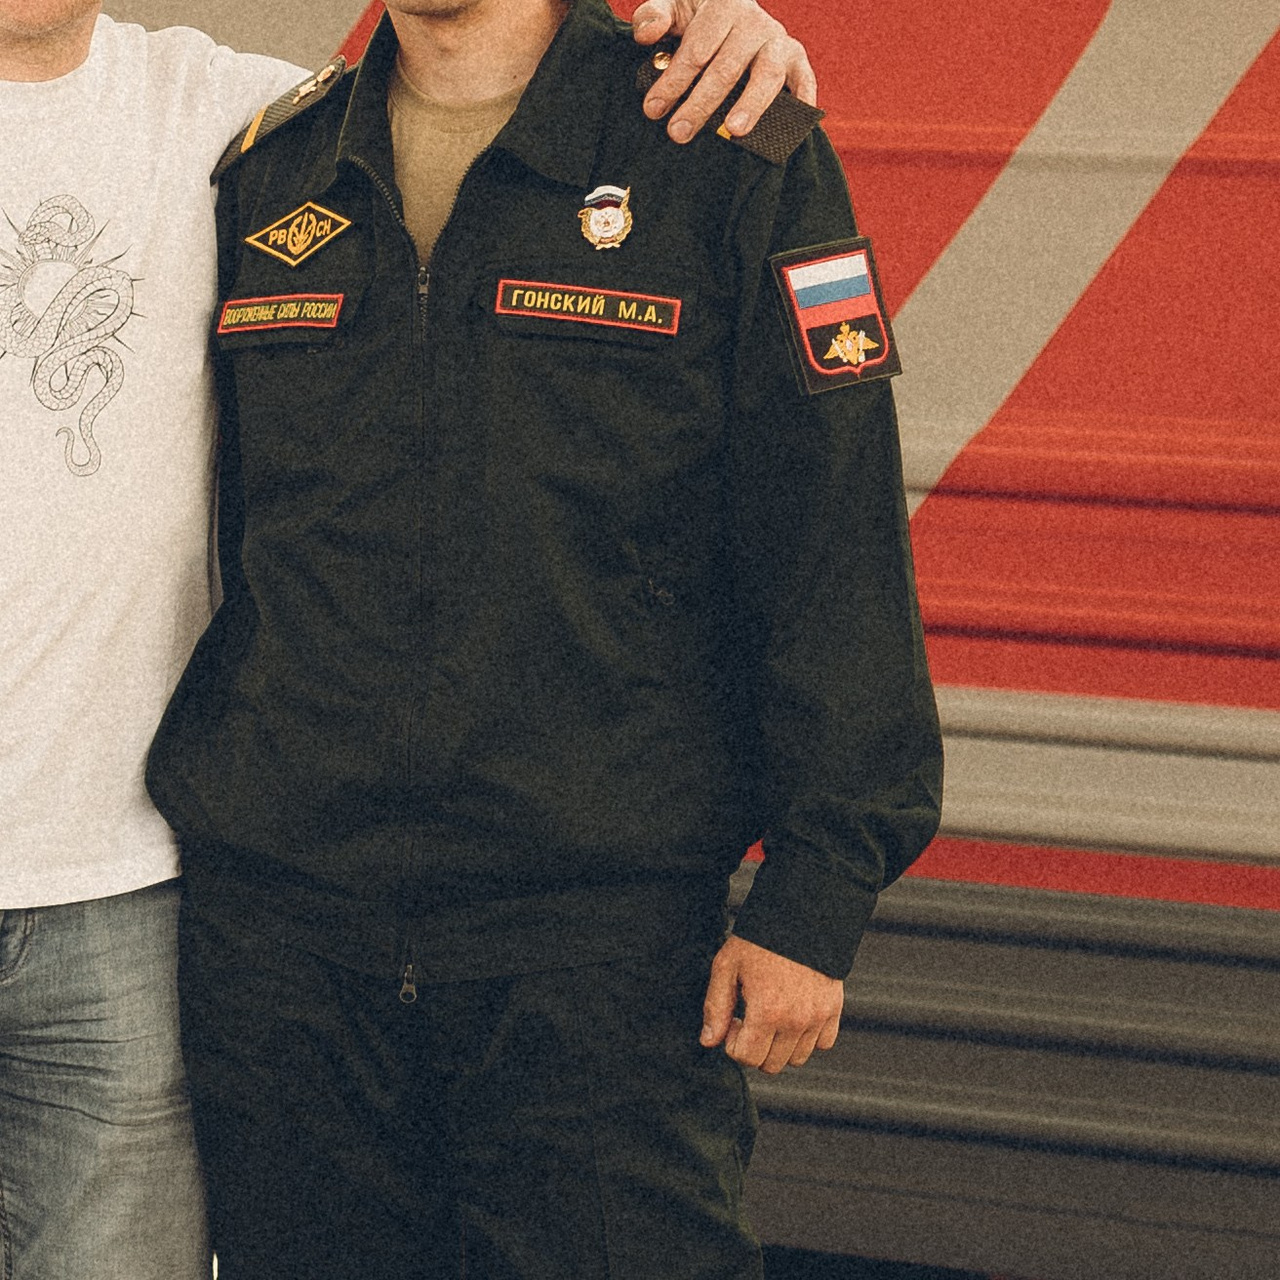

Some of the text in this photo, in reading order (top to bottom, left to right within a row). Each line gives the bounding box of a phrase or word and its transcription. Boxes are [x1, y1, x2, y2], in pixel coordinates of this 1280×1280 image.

[276, 301, 301, 320] СИЛЫ
[300, 300, 338, 319] РОССИИ
[511, 289, 663, 324] ГОНСКИЙ М.А.
